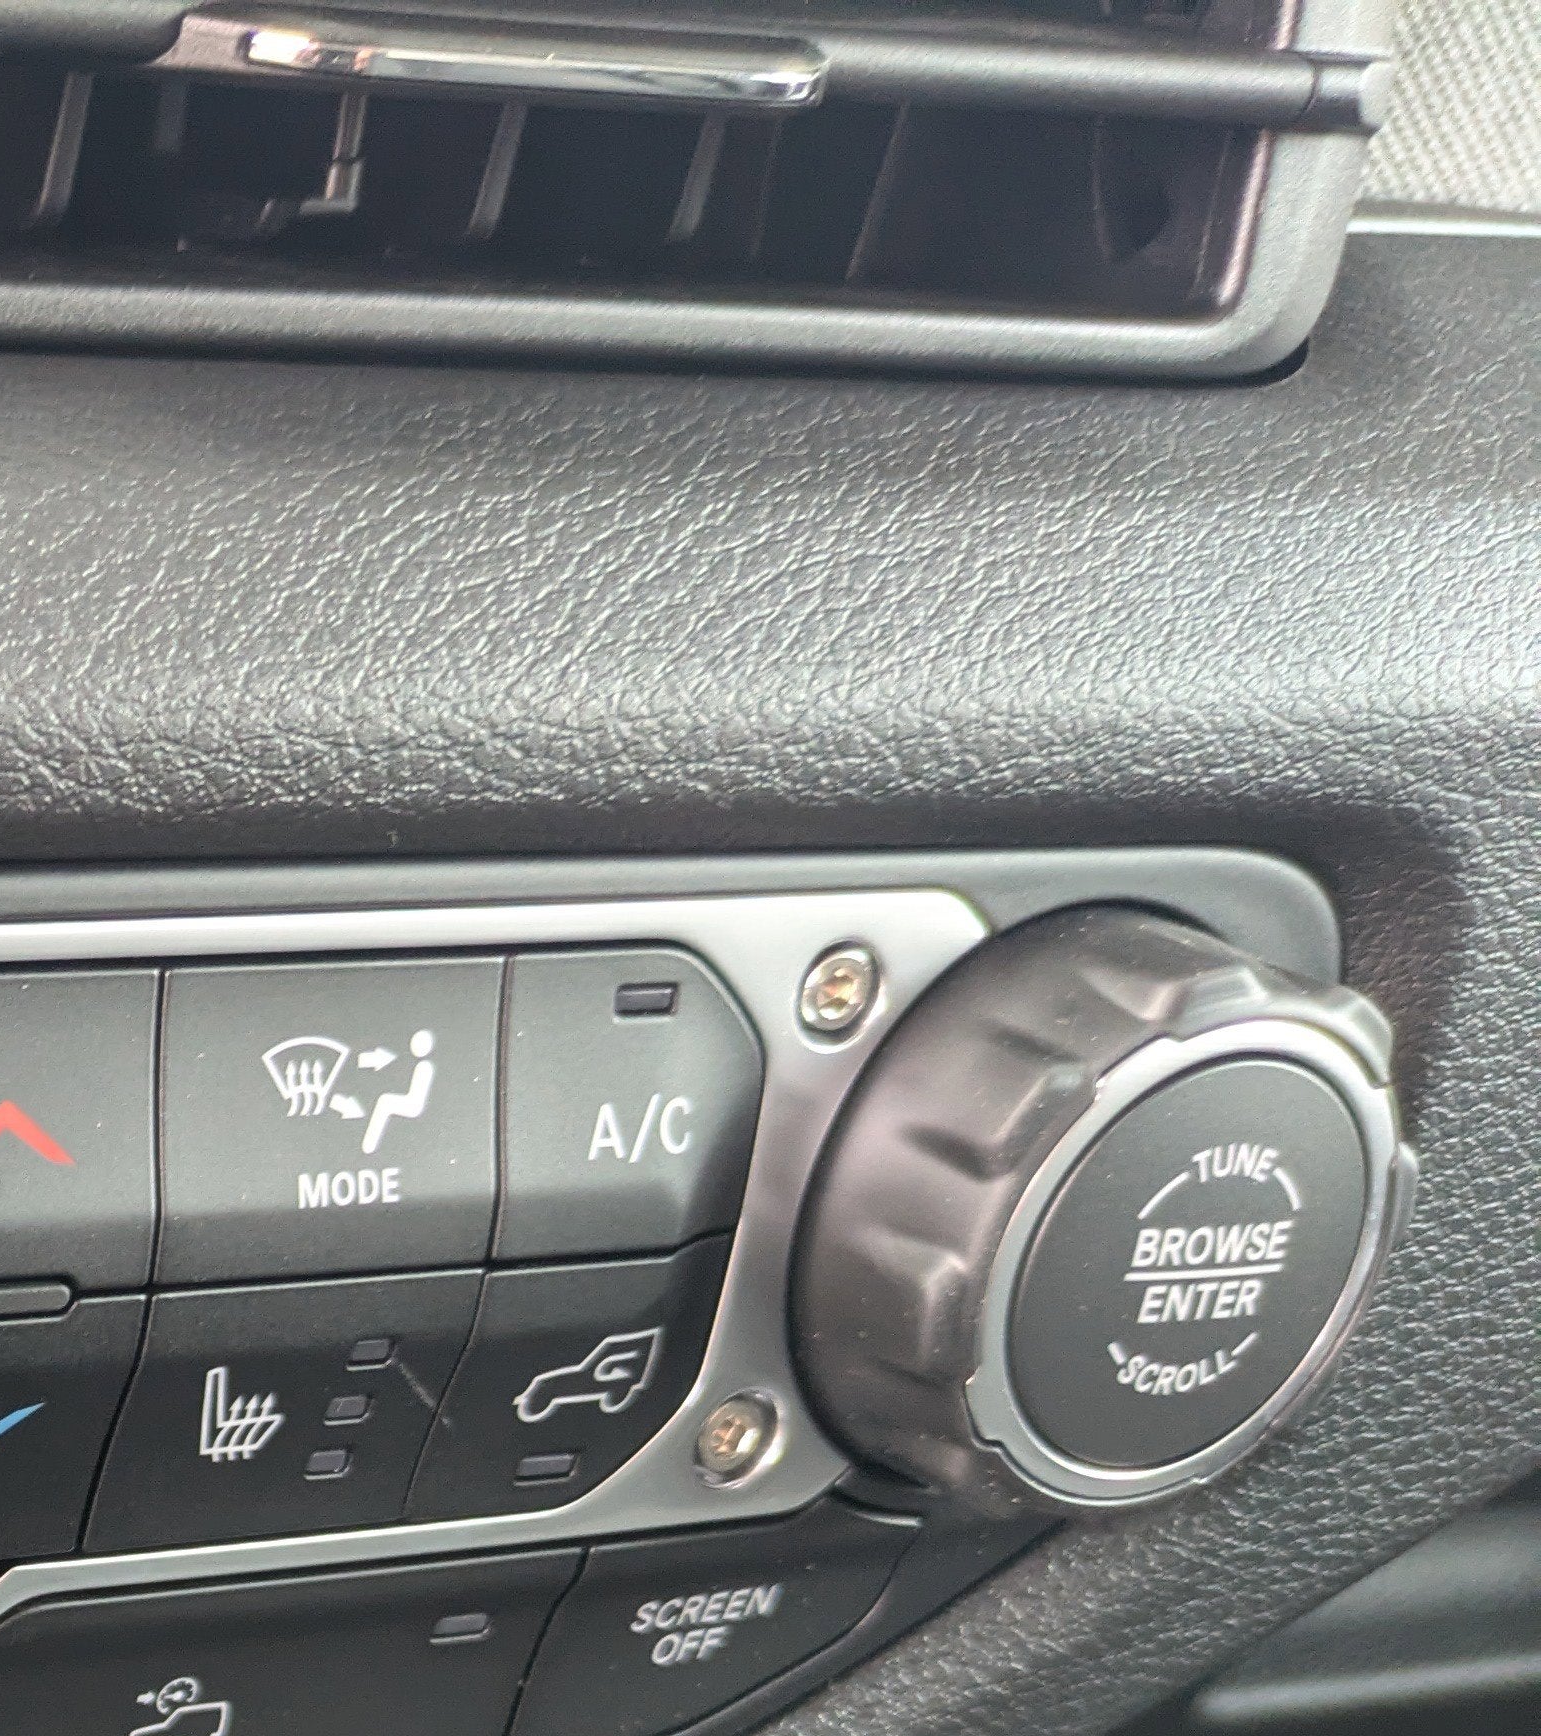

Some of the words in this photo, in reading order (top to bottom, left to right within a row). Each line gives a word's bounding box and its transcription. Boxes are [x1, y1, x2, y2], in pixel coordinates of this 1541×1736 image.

[587, 1093, 694, 1164] A/C
[1192, 1142, 1279, 1183] TUNE
[297, 1167, 401, 1209] MODE
[1131, 1219, 1295, 1267] BROWSE
[1136, 1279, 1263, 1324] ENTER
[1117, 1350, 1237, 1396] SCROLL
[630, 1582, 785, 1634] SCREEN
[651, 1625, 731, 1666] OFF
